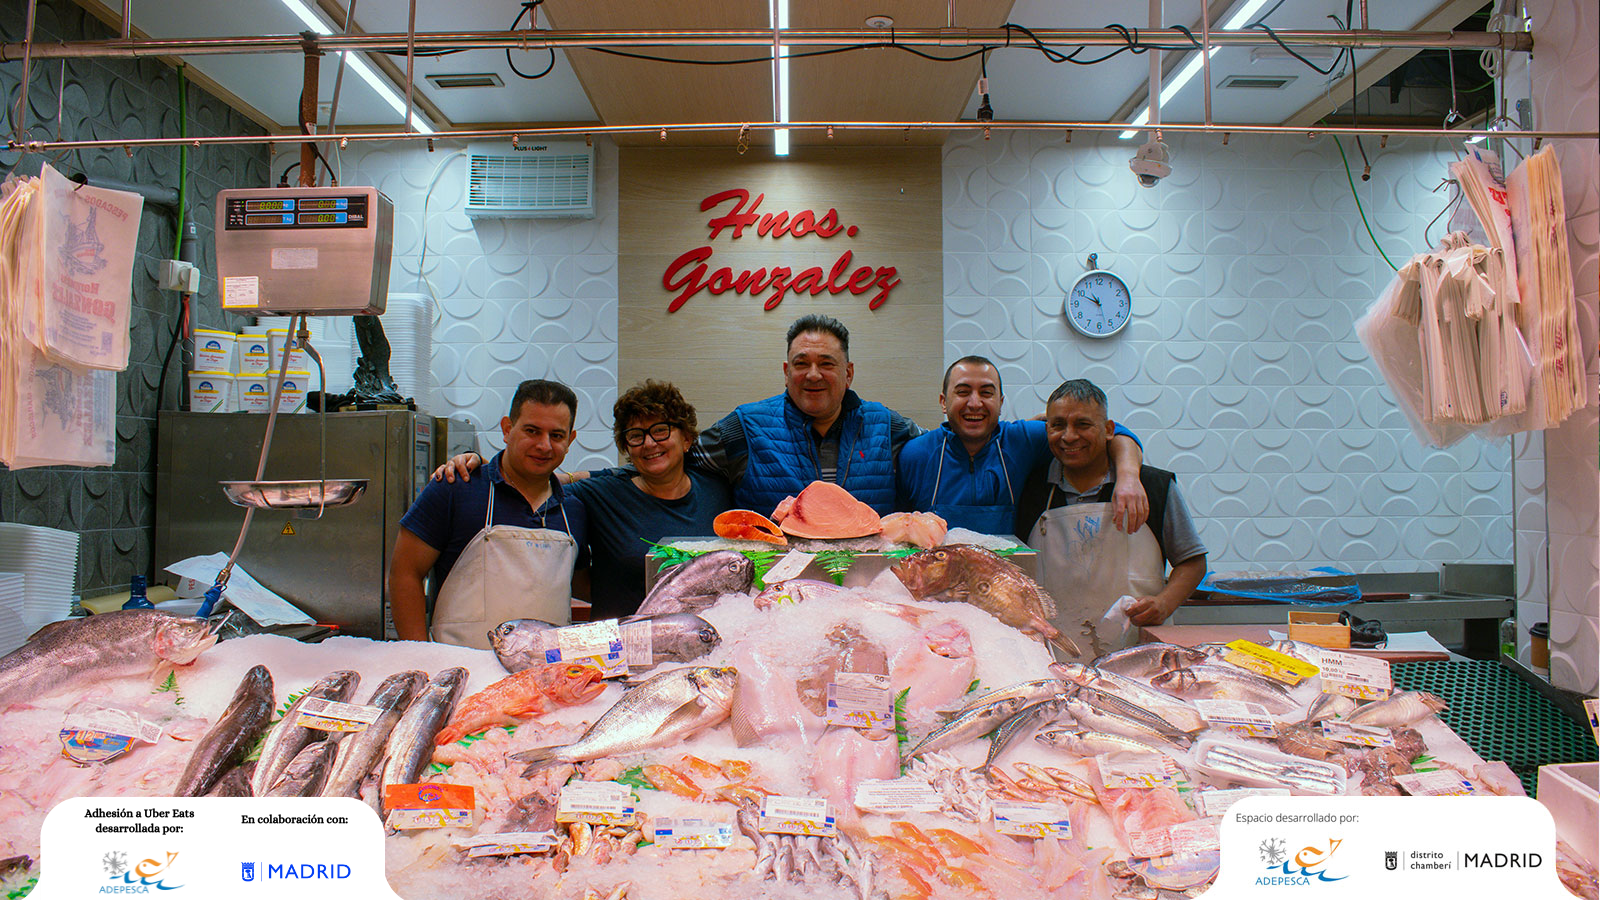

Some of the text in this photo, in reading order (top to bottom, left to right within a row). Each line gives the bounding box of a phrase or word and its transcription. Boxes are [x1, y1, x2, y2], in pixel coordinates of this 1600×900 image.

[700, 188, 859, 239] Hnos.
[662, 246, 900, 313] Gonzalez
[1116, 289, 1121, 297] 2
